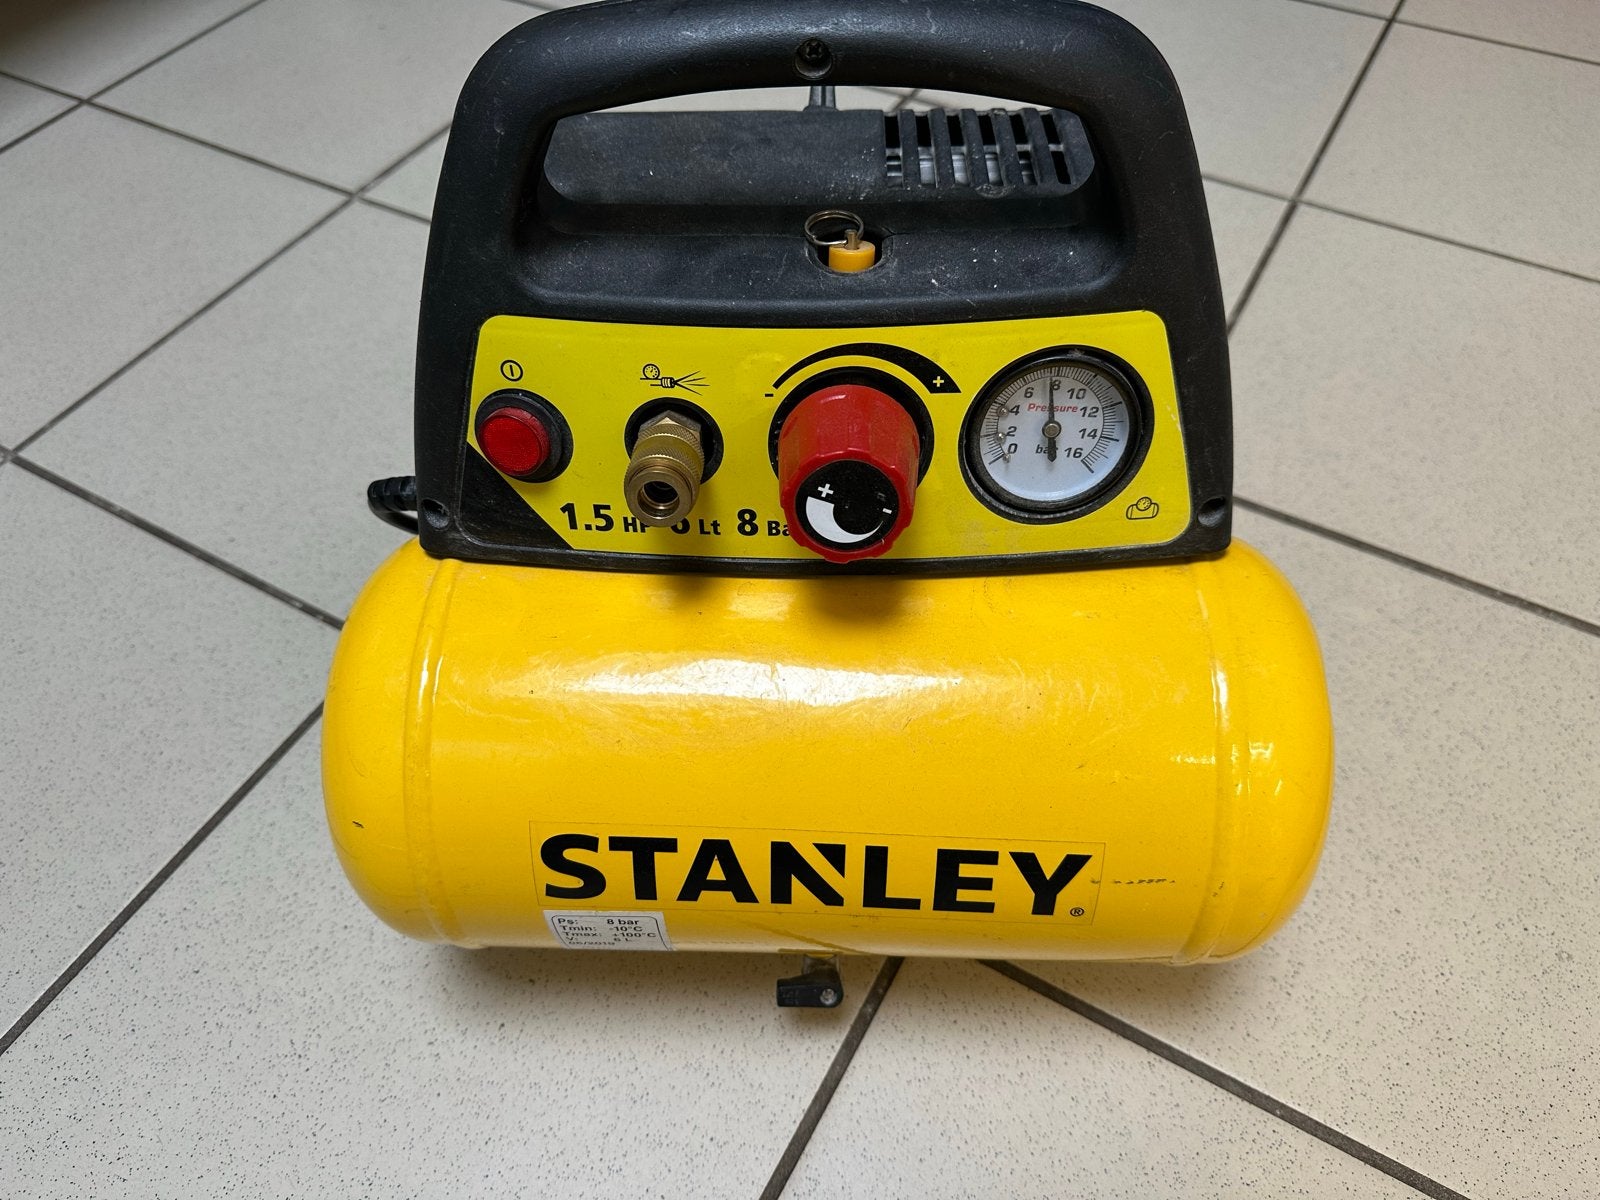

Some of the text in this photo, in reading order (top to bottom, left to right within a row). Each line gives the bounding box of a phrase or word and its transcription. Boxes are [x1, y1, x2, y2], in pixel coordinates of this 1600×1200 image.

[1051, 379, 1061, 391] 8
[1024, 386, 1035, 399] 6
[1066, 387, 1087, 400] 10
[1009, 404, 1020, 416] 4
[1079, 406, 1100, 418] 12
[1006, 425, 1017, 437] 2
[1078, 428, 1098, 440] 14
[1007, 442, 1018, 454] 0
[1035, 443, 1059, 454] ba
[1064, 447, 1084, 459] 16
[559, 502, 615, 532] 1.5
[698, 518, 721, 536] Lt
[736, 508, 759, 537] 8
[767, 520, 791, 537] Ba
[539, 833, 1094, 916] STANLEY
[618, 918, 640, 926] bar
